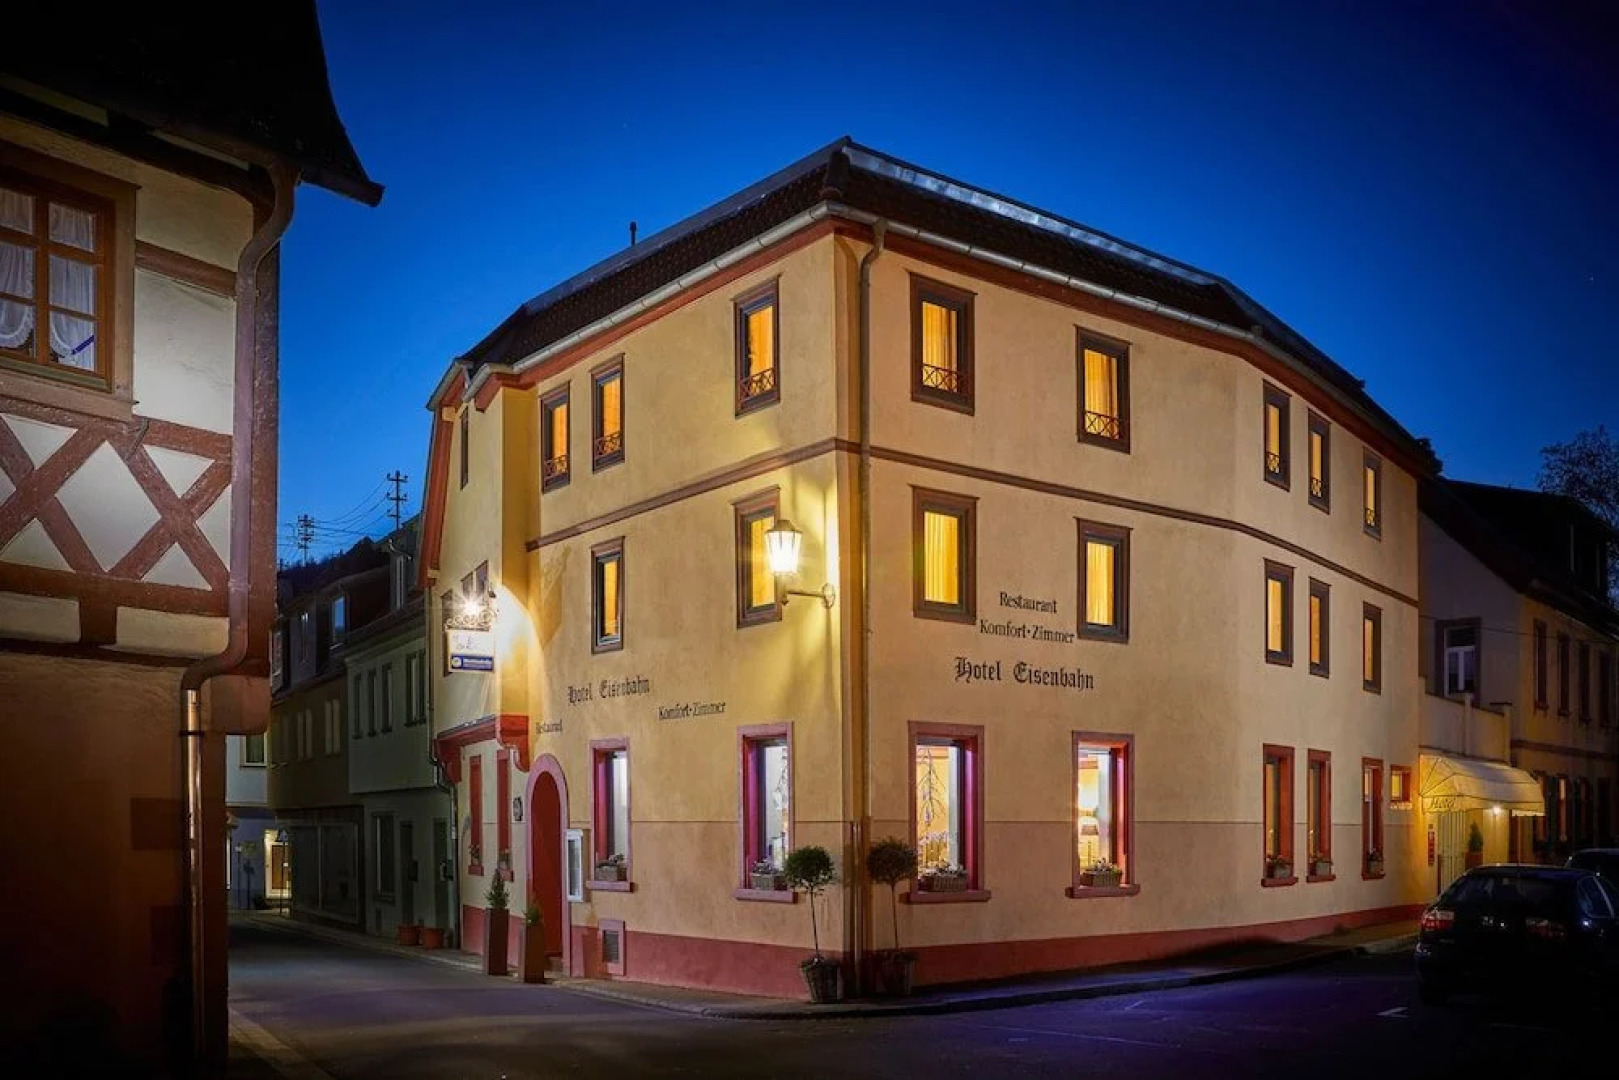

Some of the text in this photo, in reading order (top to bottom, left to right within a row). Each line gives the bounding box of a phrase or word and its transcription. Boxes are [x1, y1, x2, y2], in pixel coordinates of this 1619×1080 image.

[1000, 591, 1057, 614] Restaurant
[955, 656, 1094, 692] Hotel Eisenbahn
[568, 675, 650, 706] Hotel Eisenbahn
